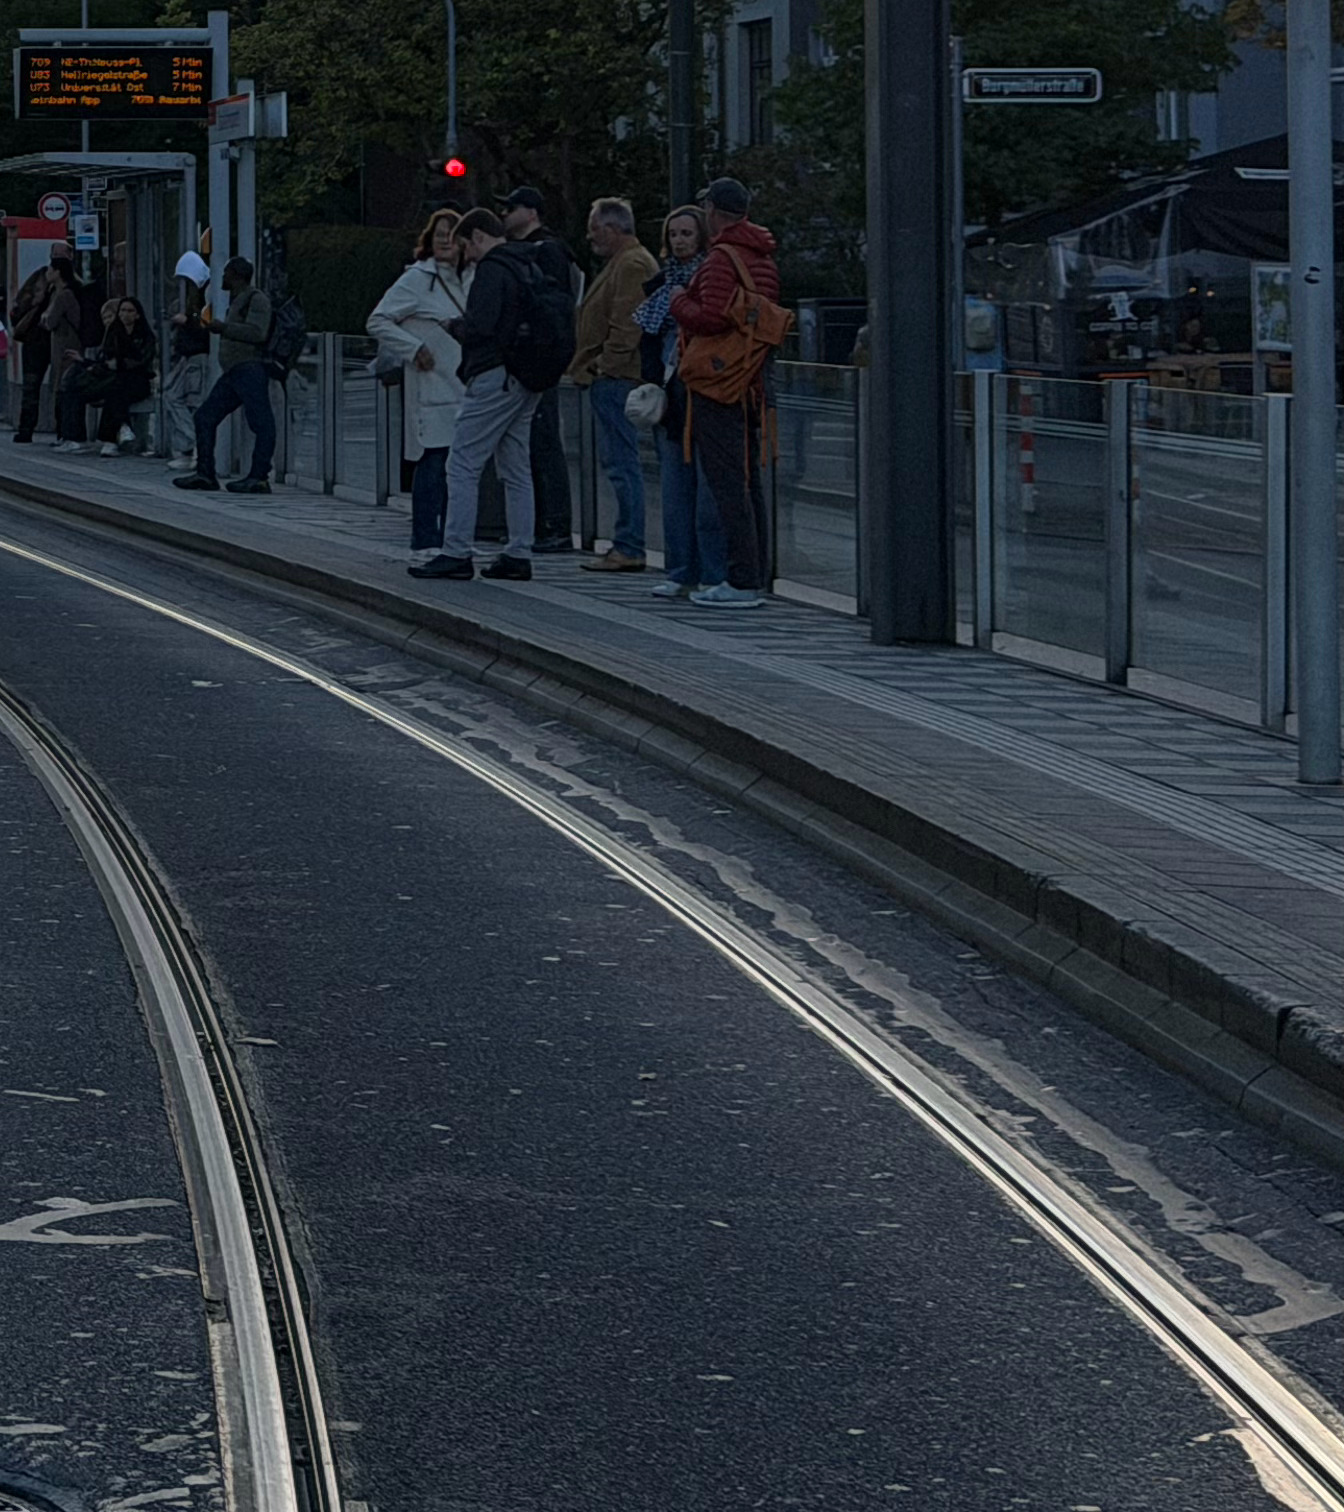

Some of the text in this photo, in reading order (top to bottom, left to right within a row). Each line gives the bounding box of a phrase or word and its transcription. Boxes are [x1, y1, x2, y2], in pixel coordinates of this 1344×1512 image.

[30, 57, 51, 67] 709
[182, 57, 203, 67] Min
[182, 70, 203, 80] Min
[182, 83, 203, 92] Min
